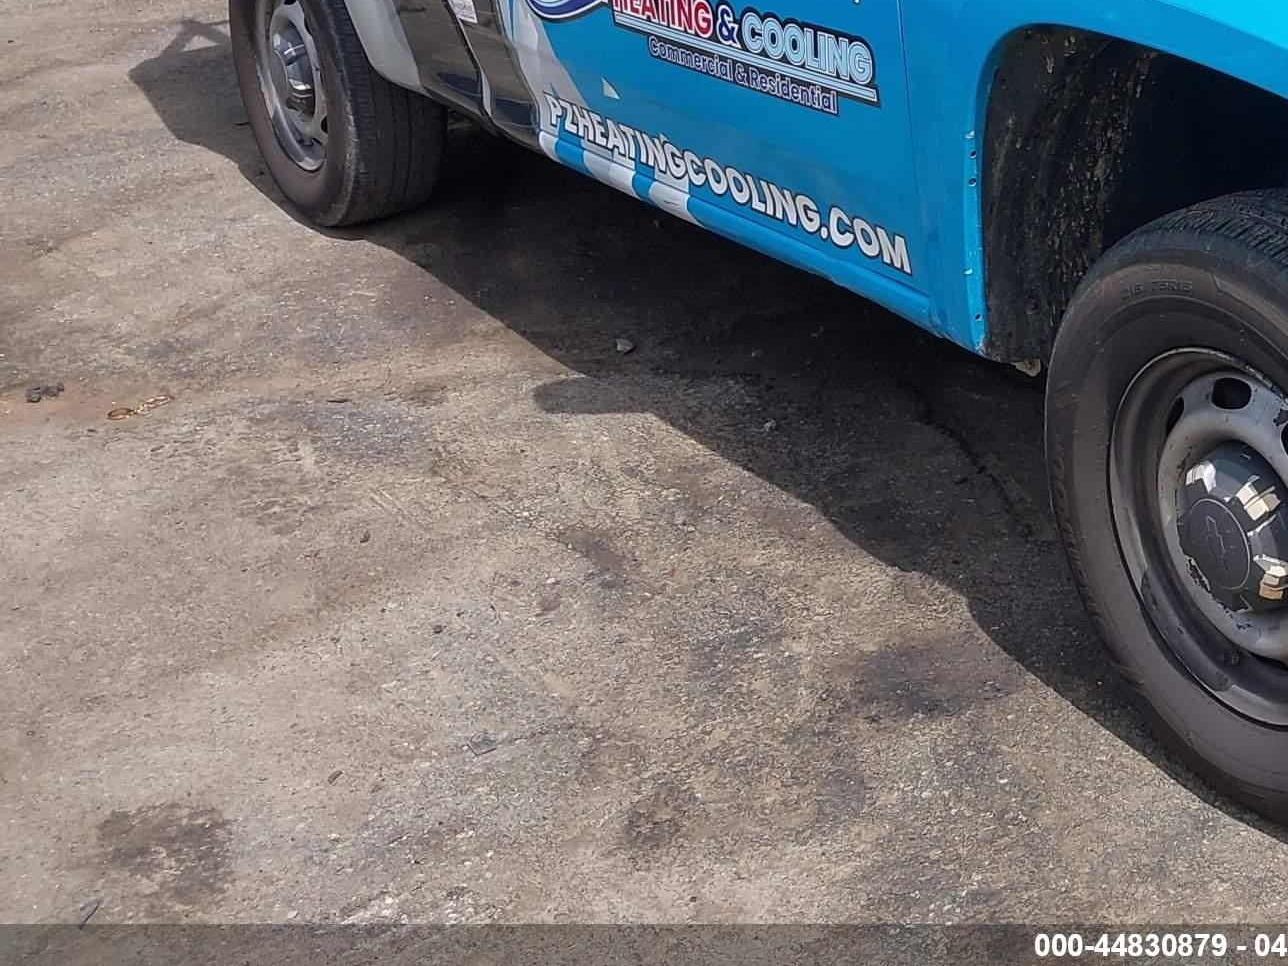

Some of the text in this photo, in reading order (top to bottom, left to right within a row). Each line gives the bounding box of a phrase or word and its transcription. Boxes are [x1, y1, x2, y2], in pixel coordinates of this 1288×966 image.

[648, 35, 839, 116] Commercial & Residential
[716, 4, 742, 48] &
[742, 12, 874, 85] COOLING
[548, 95, 913, 276] PZHEATINGCOOLING.COM
